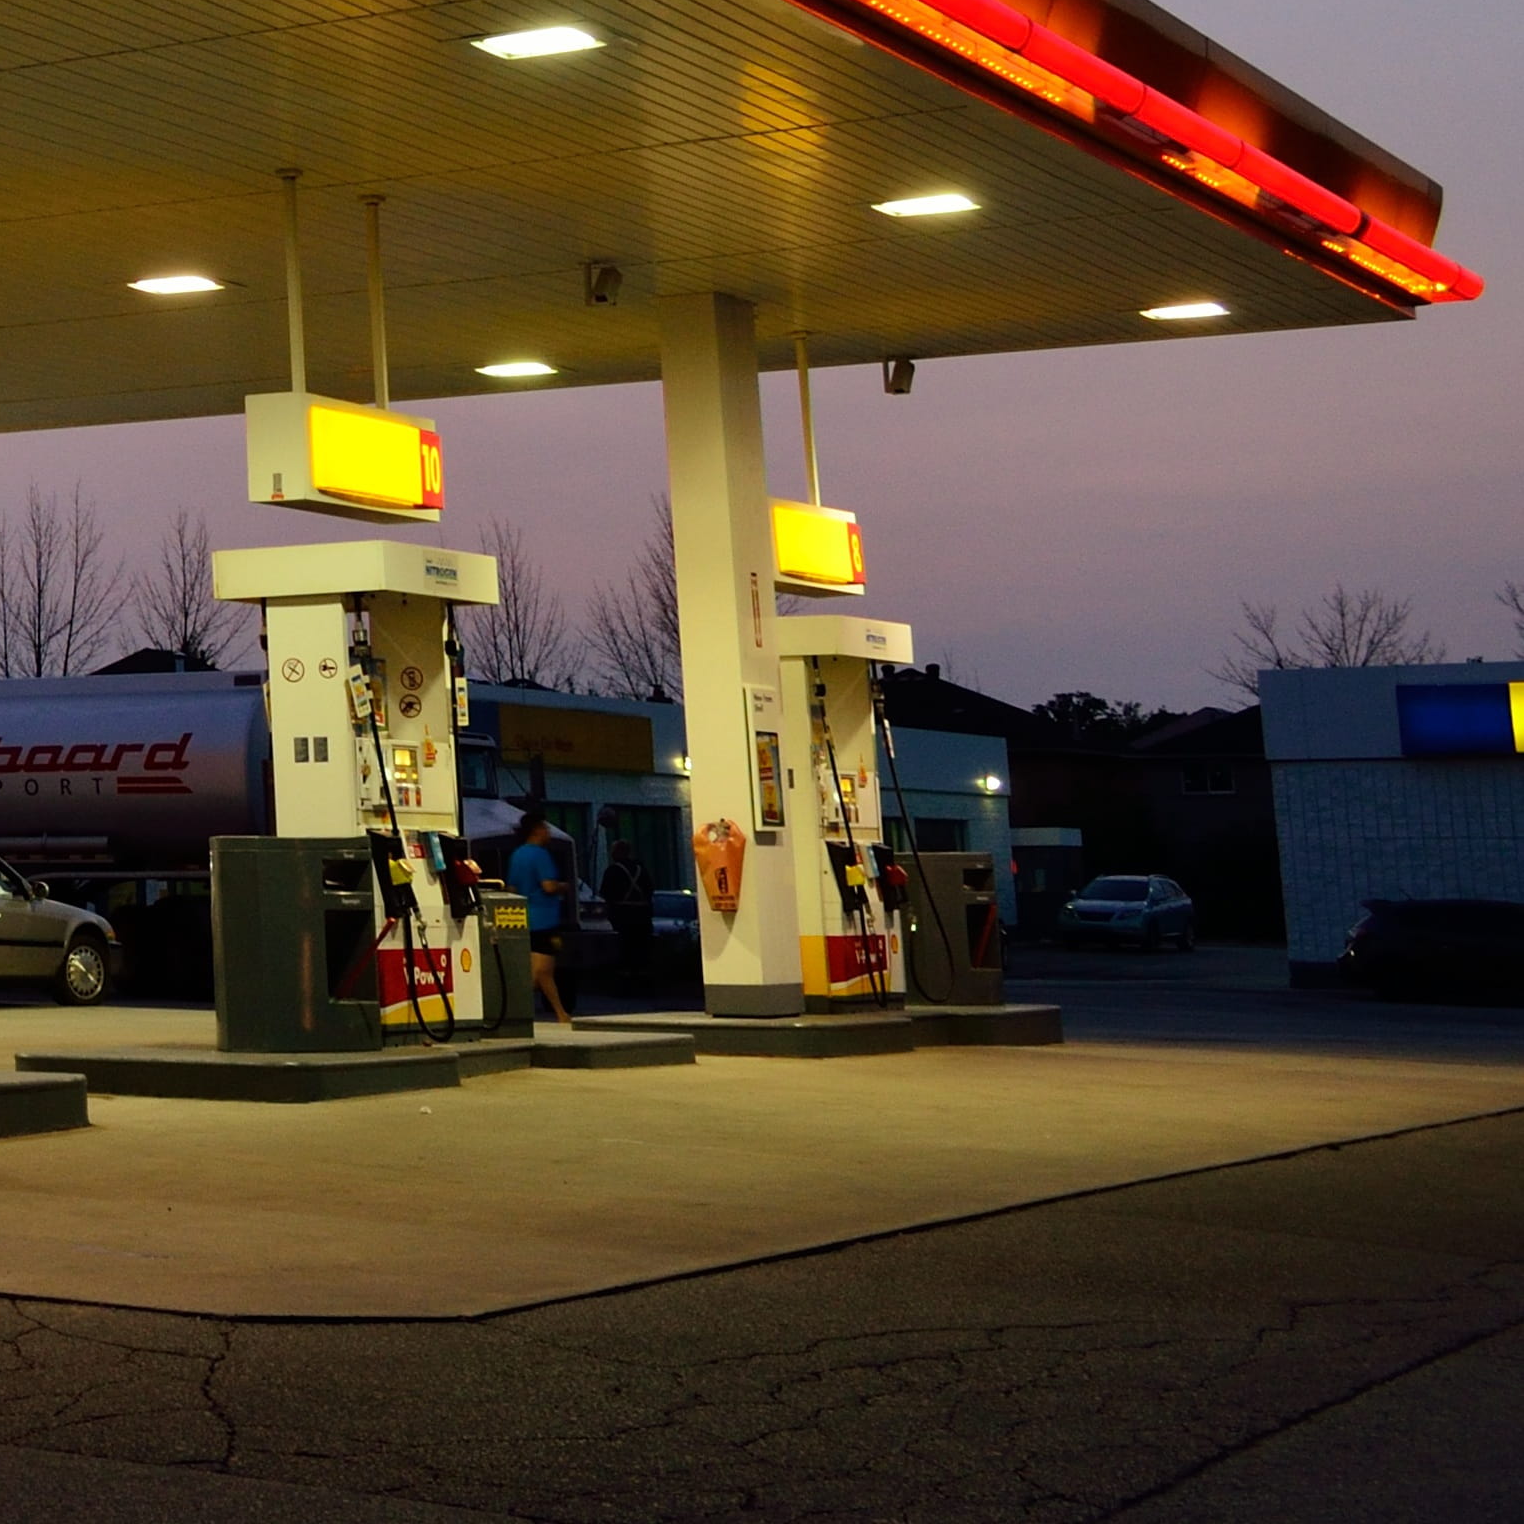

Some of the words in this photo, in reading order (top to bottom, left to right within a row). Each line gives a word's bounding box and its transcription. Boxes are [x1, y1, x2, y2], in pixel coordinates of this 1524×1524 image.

[421, 443, 442, 494] 10
[851, 532, 863, 573] 8
[403, 965, 445, 986] VPowr
